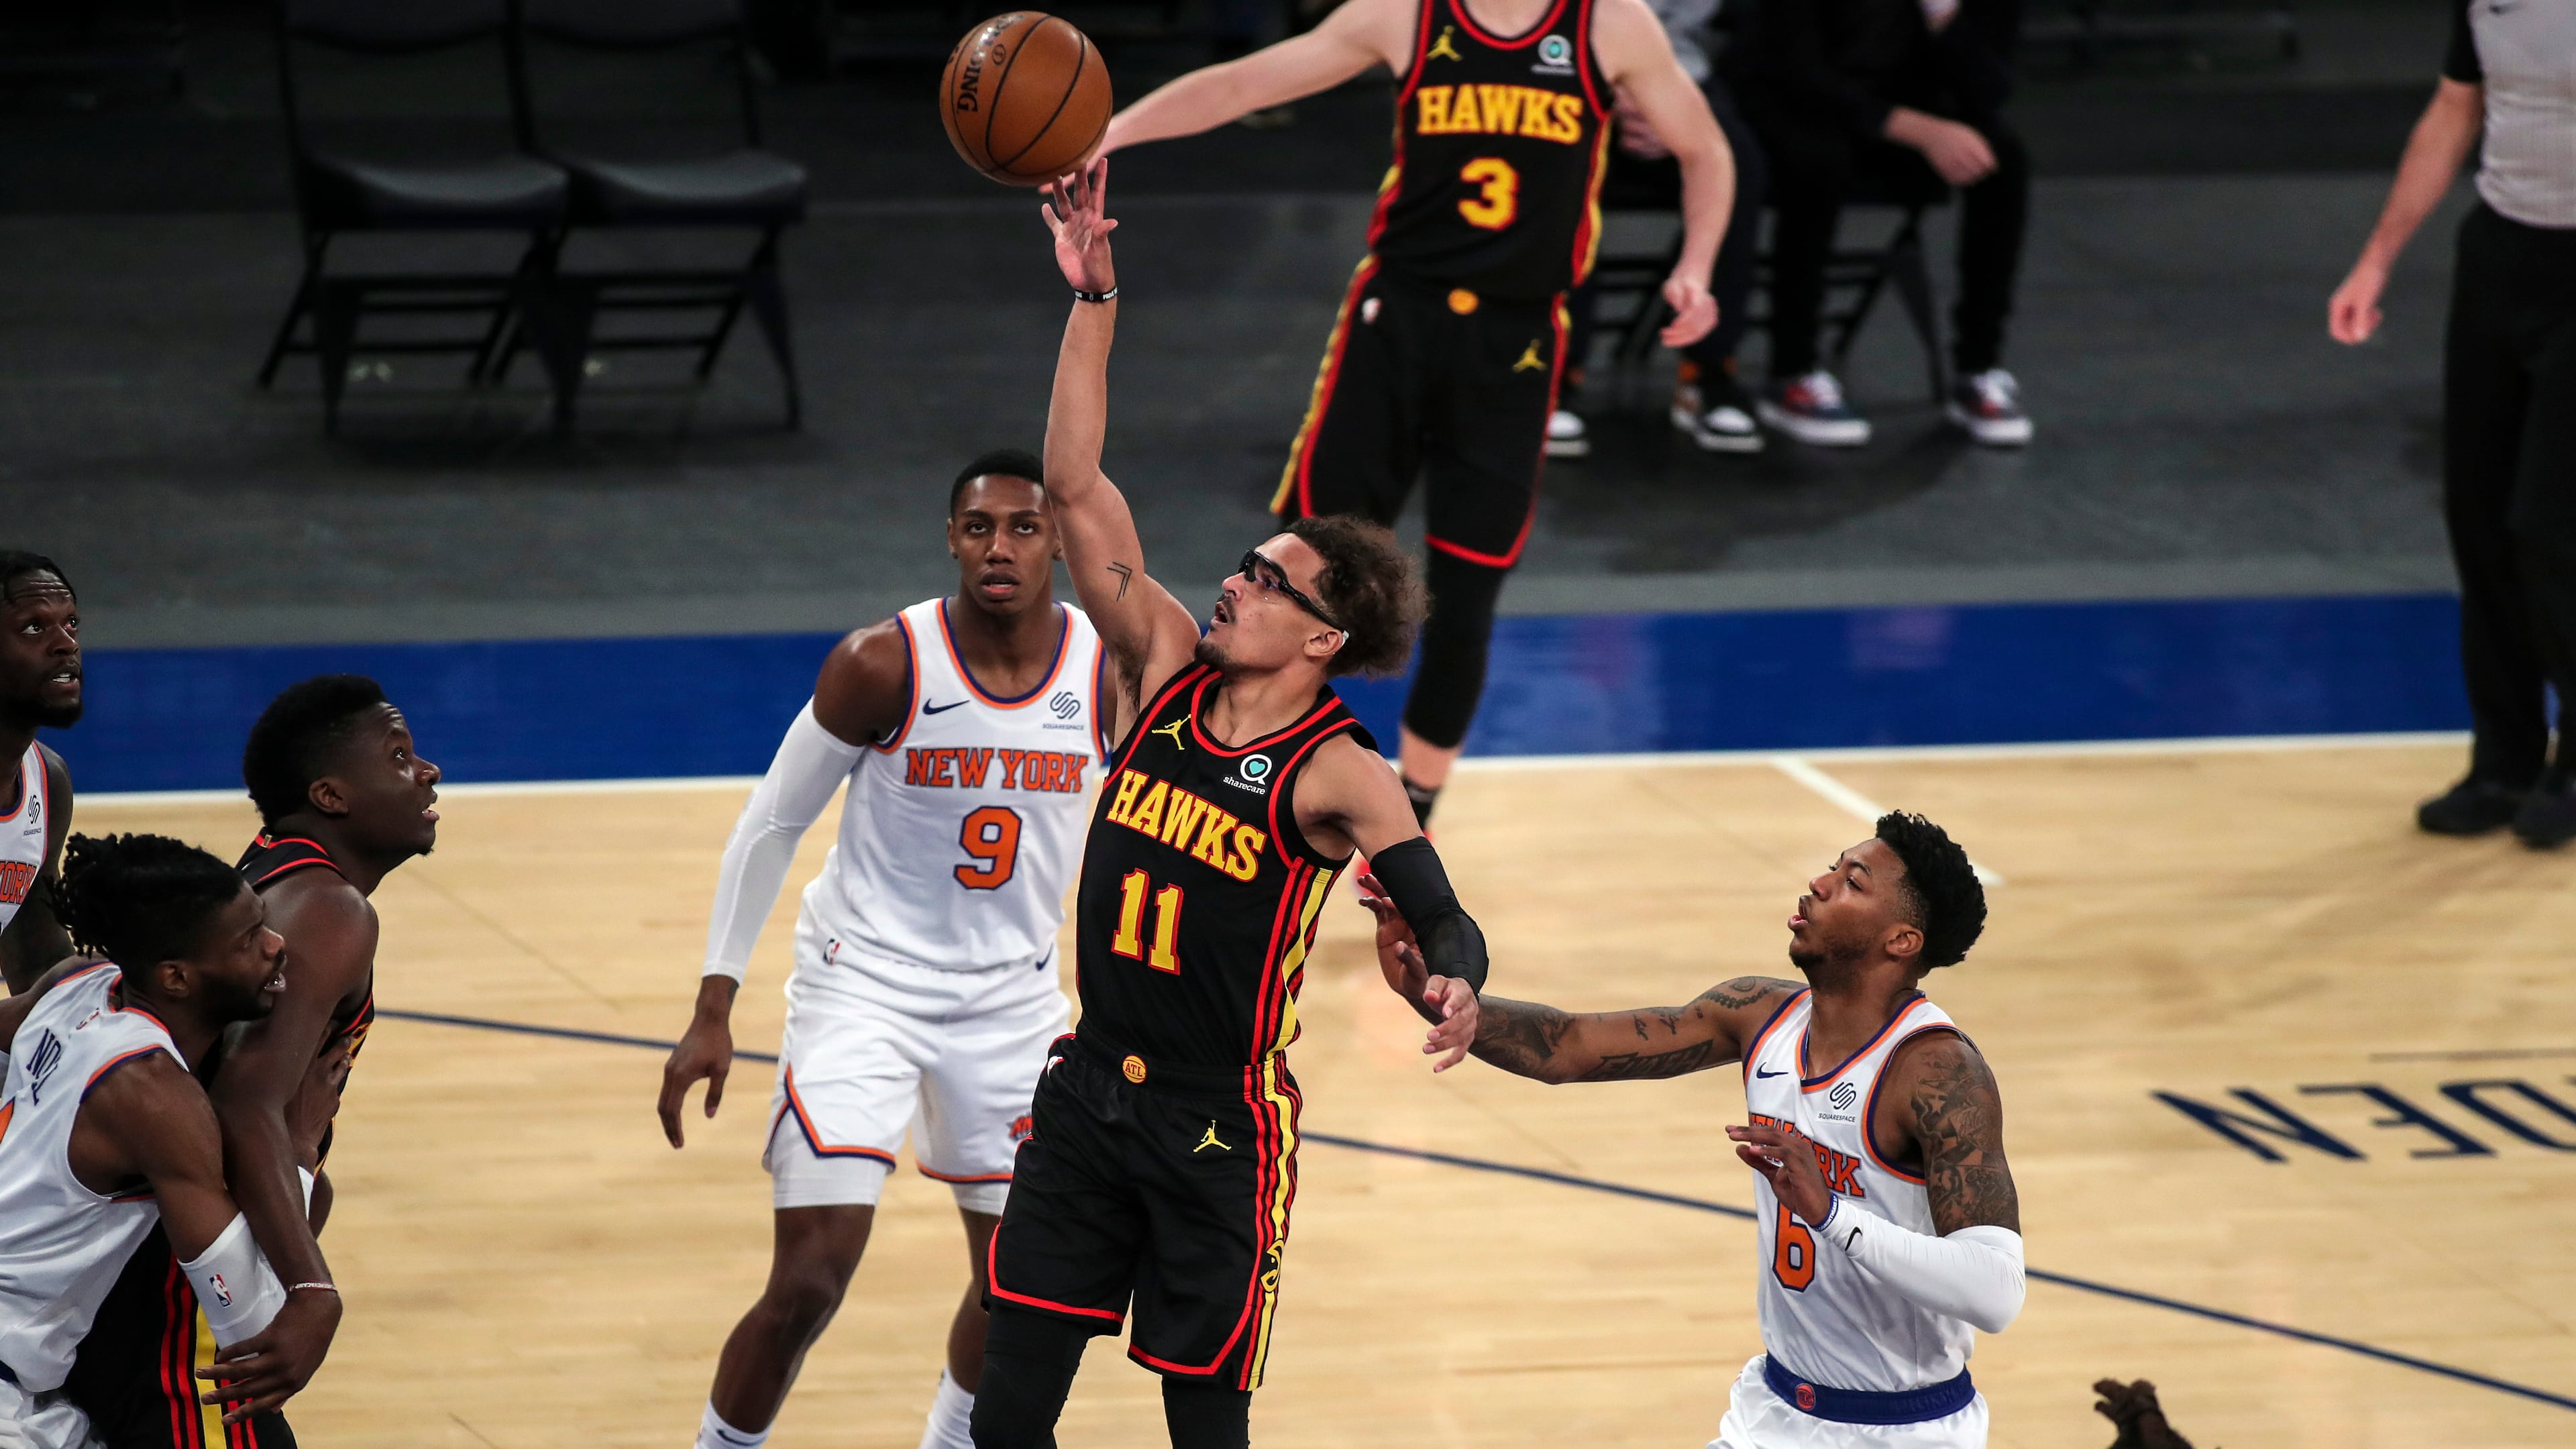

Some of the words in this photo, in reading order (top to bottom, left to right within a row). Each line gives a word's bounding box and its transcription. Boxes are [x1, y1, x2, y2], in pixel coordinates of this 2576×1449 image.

[1416, 84, 1583, 144] HAWKS
[1457, 156, 1519, 231] 3
[904, 747, 995, 788] NEW
[998, 749, 1089, 793] YORK
[1223, 776, 1266, 795] sharecare
[953, 806, 1022, 890] 9
[1106, 769, 1267, 883] HAWKS
[0, 861, 38, 905] ORK
[1111, 867, 1183, 975] 11
[1125, 1063, 1142, 1077] ATL
[1818, 1112, 1856, 1123] SQUARESPACE
[2149, 1075, 2576, 1165] DEN
[1772, 1201, 1816, 1293] 6
